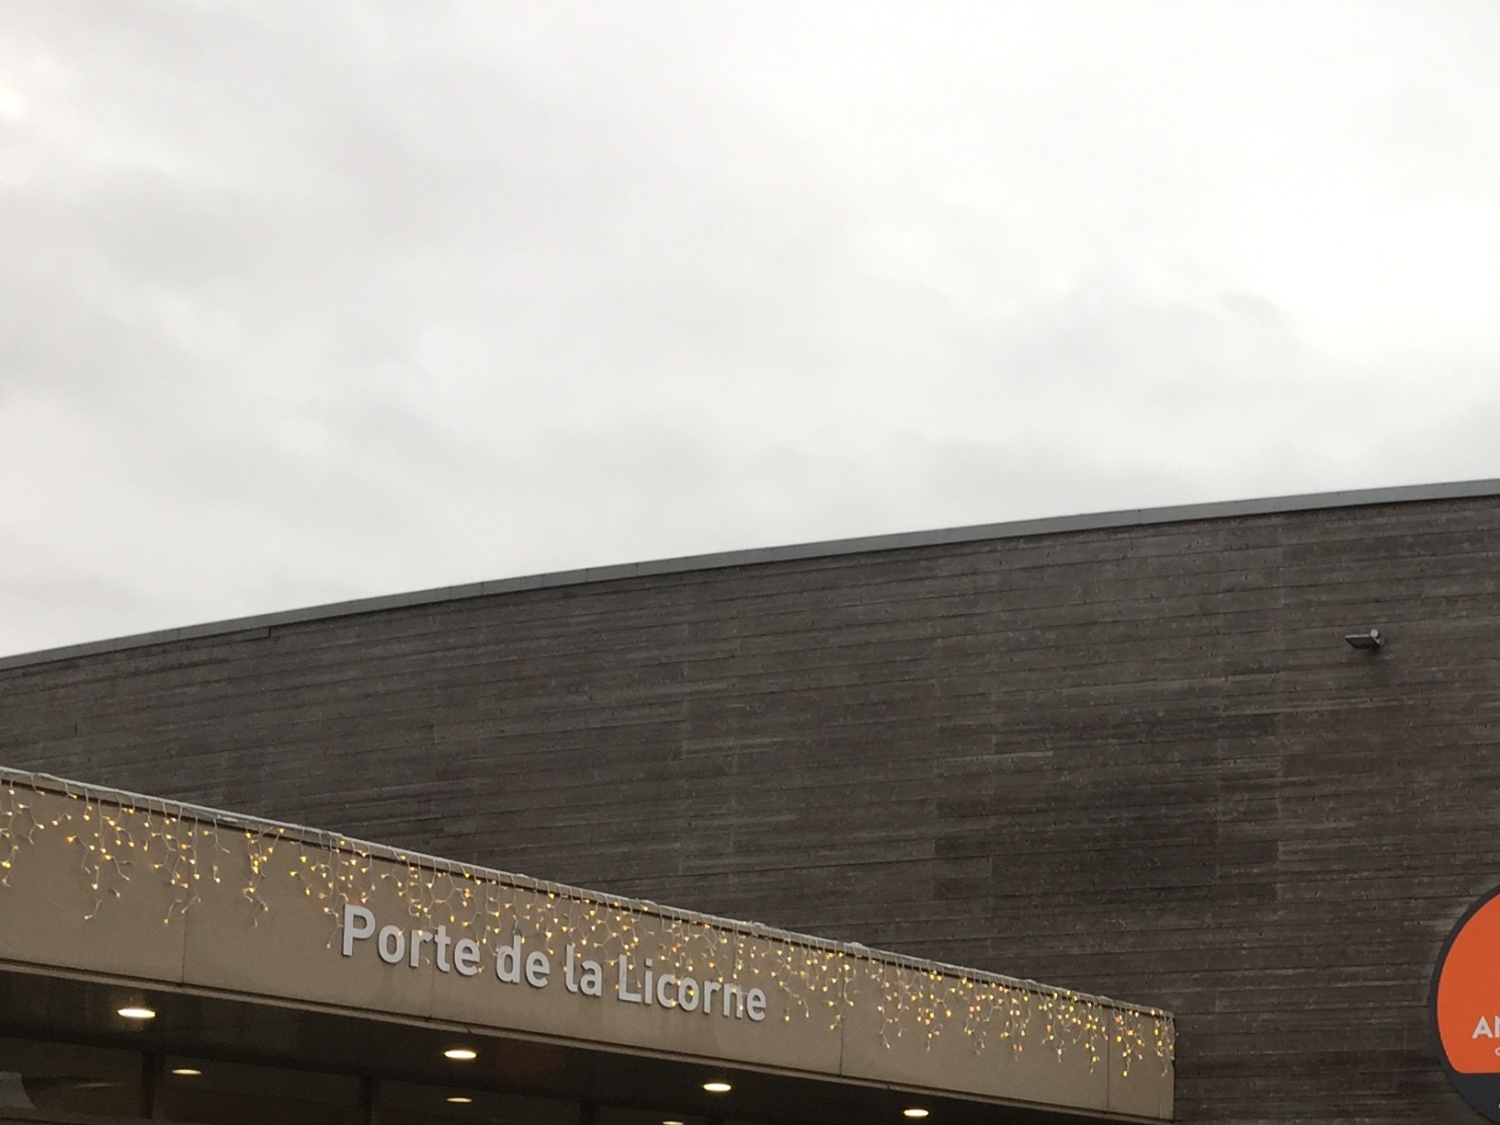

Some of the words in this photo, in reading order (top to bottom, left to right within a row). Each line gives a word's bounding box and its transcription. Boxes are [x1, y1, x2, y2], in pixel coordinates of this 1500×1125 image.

[342, 904, 481, 976] Porte
[496, 933, 551, 987] de
[565, 943, 602, 997] la
[617, 953, 767, 1021] Licorne
